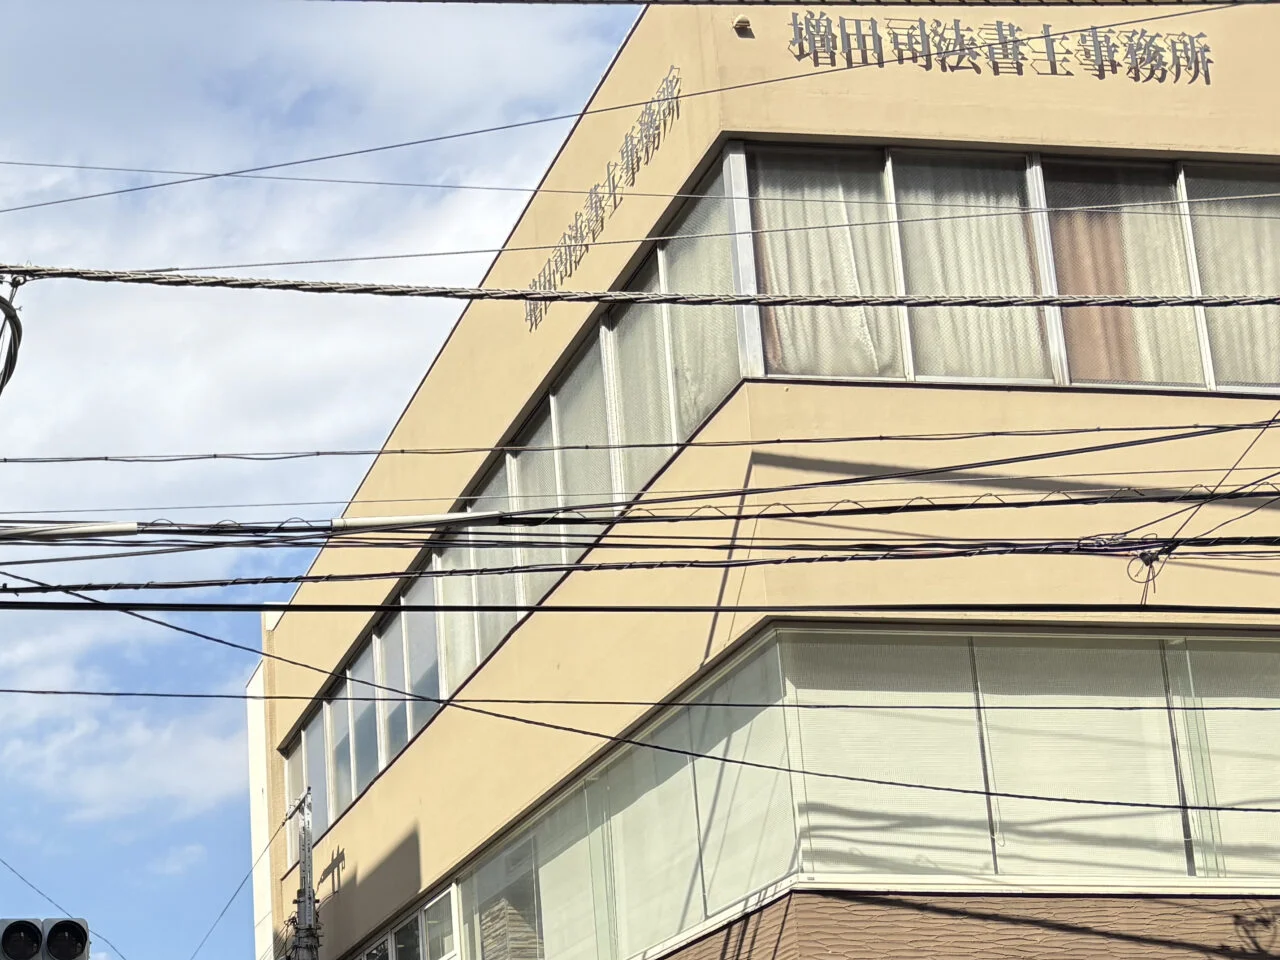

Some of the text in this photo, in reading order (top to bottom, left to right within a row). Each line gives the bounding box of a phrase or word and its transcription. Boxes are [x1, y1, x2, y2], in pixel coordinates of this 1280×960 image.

[789, 11, 1211, 85] 増田司法書士事務所
